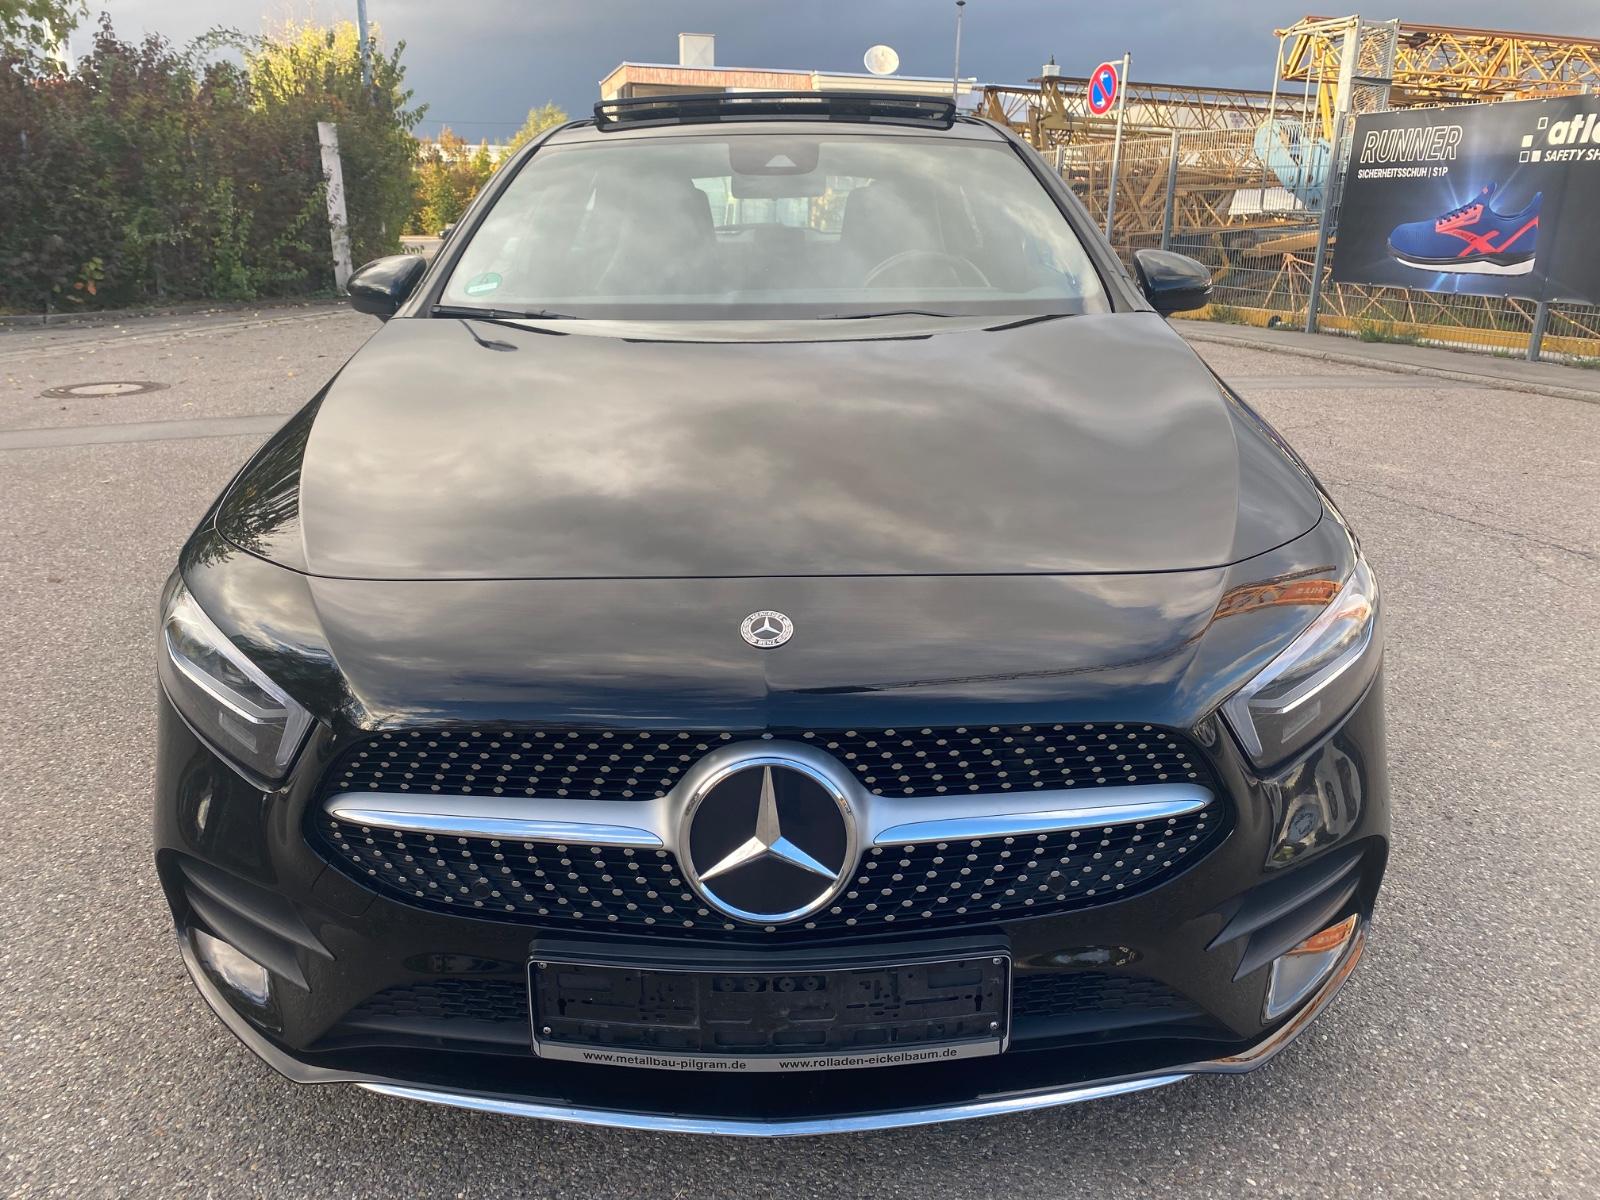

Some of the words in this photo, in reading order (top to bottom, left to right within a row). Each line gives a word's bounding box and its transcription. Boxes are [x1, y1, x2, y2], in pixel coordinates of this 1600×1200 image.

[1360, 125, 1463, 163] RUNNER
[1544, 149, 1586, 162] SAFETY
[1357, 168, 1427, 179] SICHERHEITSSCHUH
[1432, 166, 1448, 177] S1P
[583, 1051, 747, 1070] www.metallbau-pilgram.de
[779, 1048, 957, 1069] www.rolladen-eickelbaum.de
